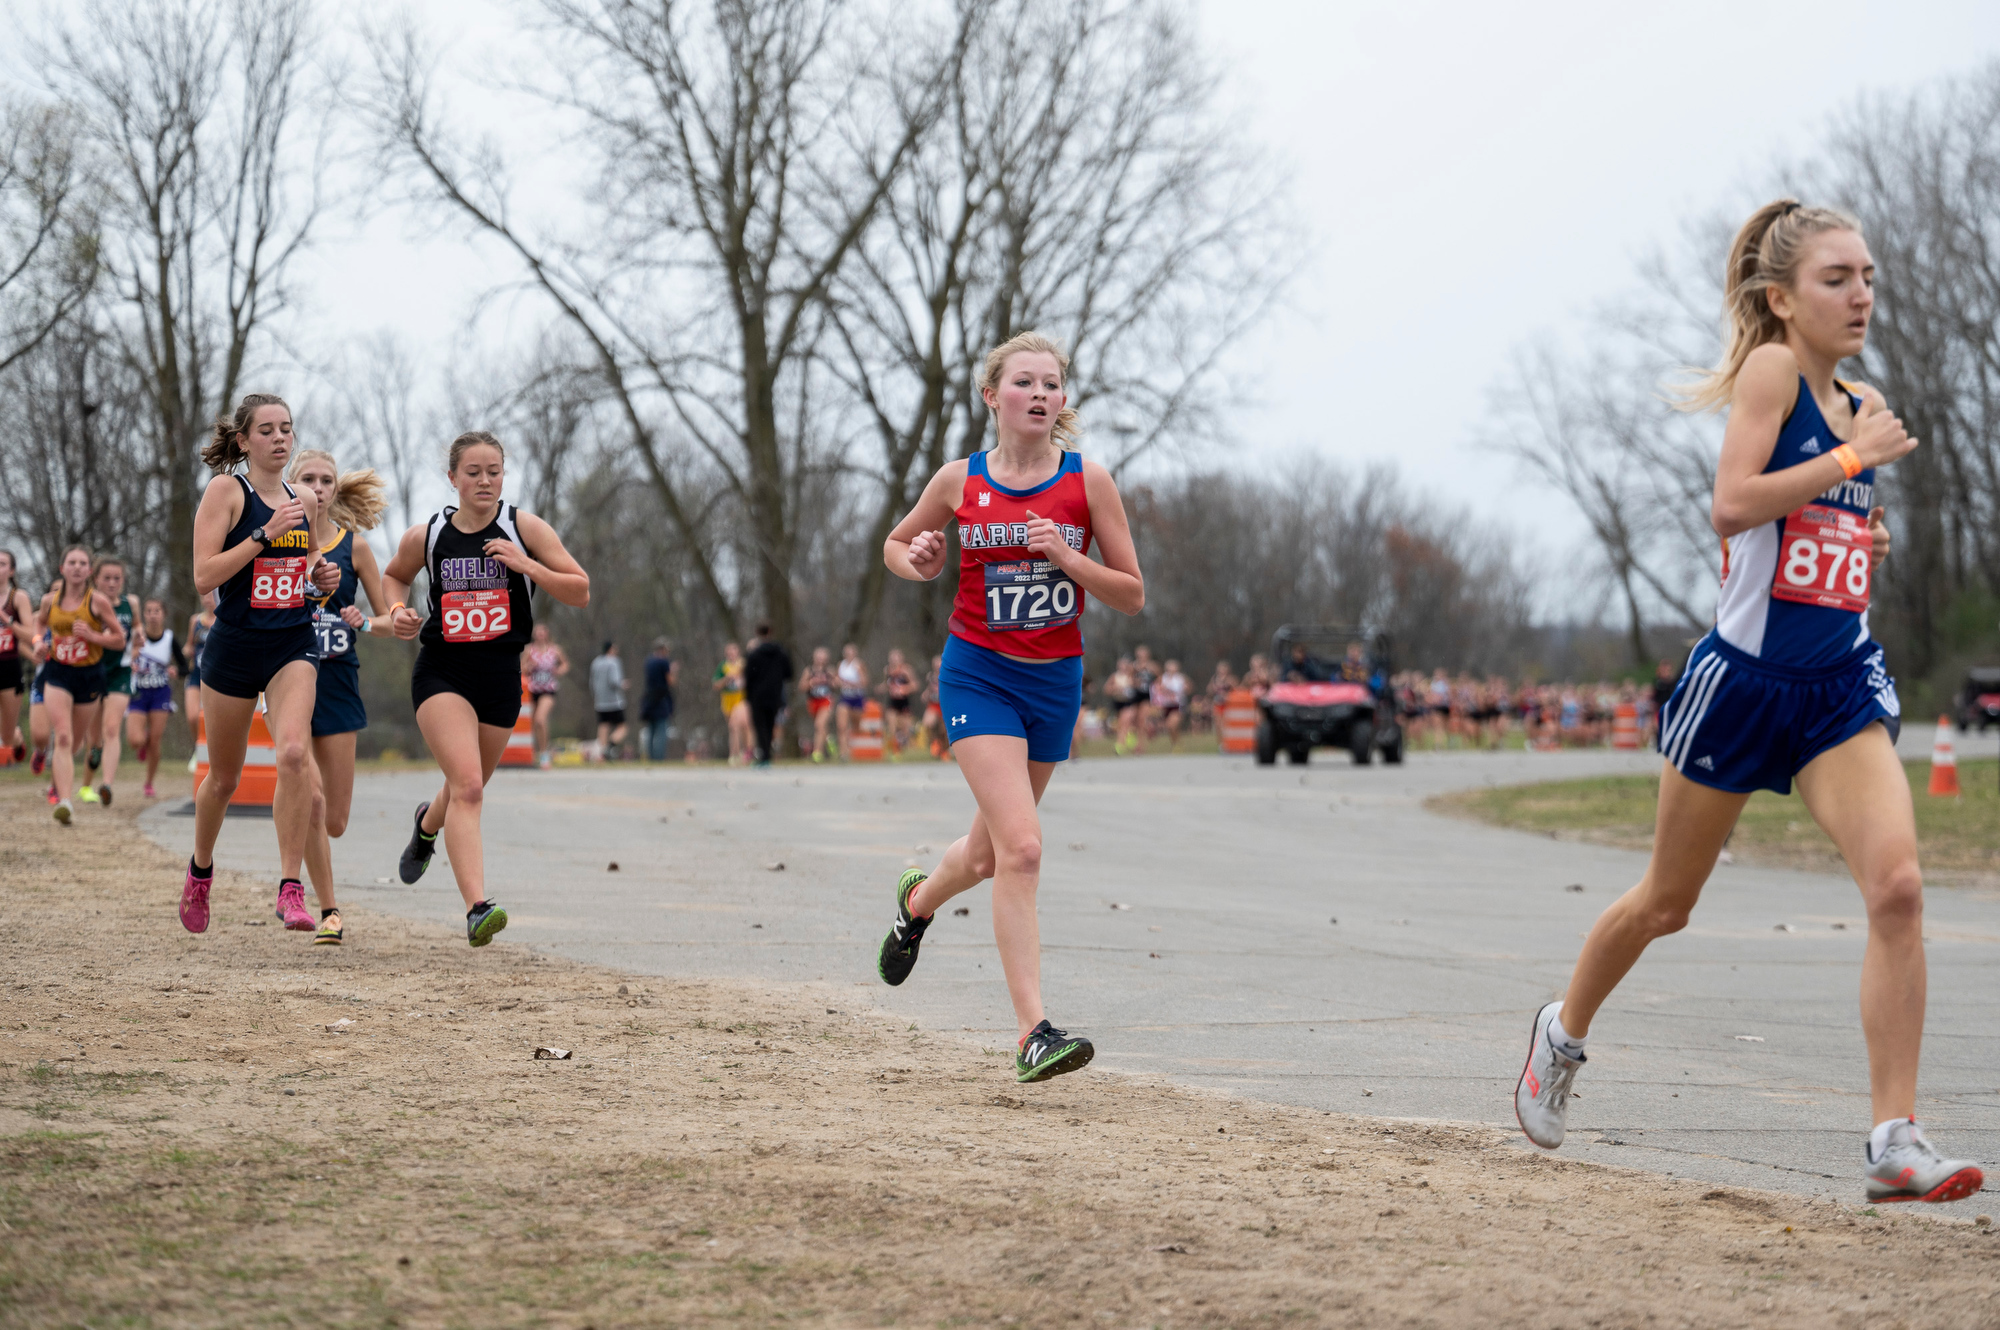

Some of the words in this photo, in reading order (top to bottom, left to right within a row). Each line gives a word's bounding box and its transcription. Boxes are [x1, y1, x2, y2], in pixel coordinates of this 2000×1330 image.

[441, 557, 507, 580] SHELBY
[1031, 573, 1049, 581] FINAL
[1783, 538, 1869, 596] 878
[254, 574, 305, 600] 884
[441, 580, 469, 591] CROSS
[470, 578, 509, 590] COUNTRY
[987, 581, 1075, 620] 1720
[444, 607, 508, 634] 902
